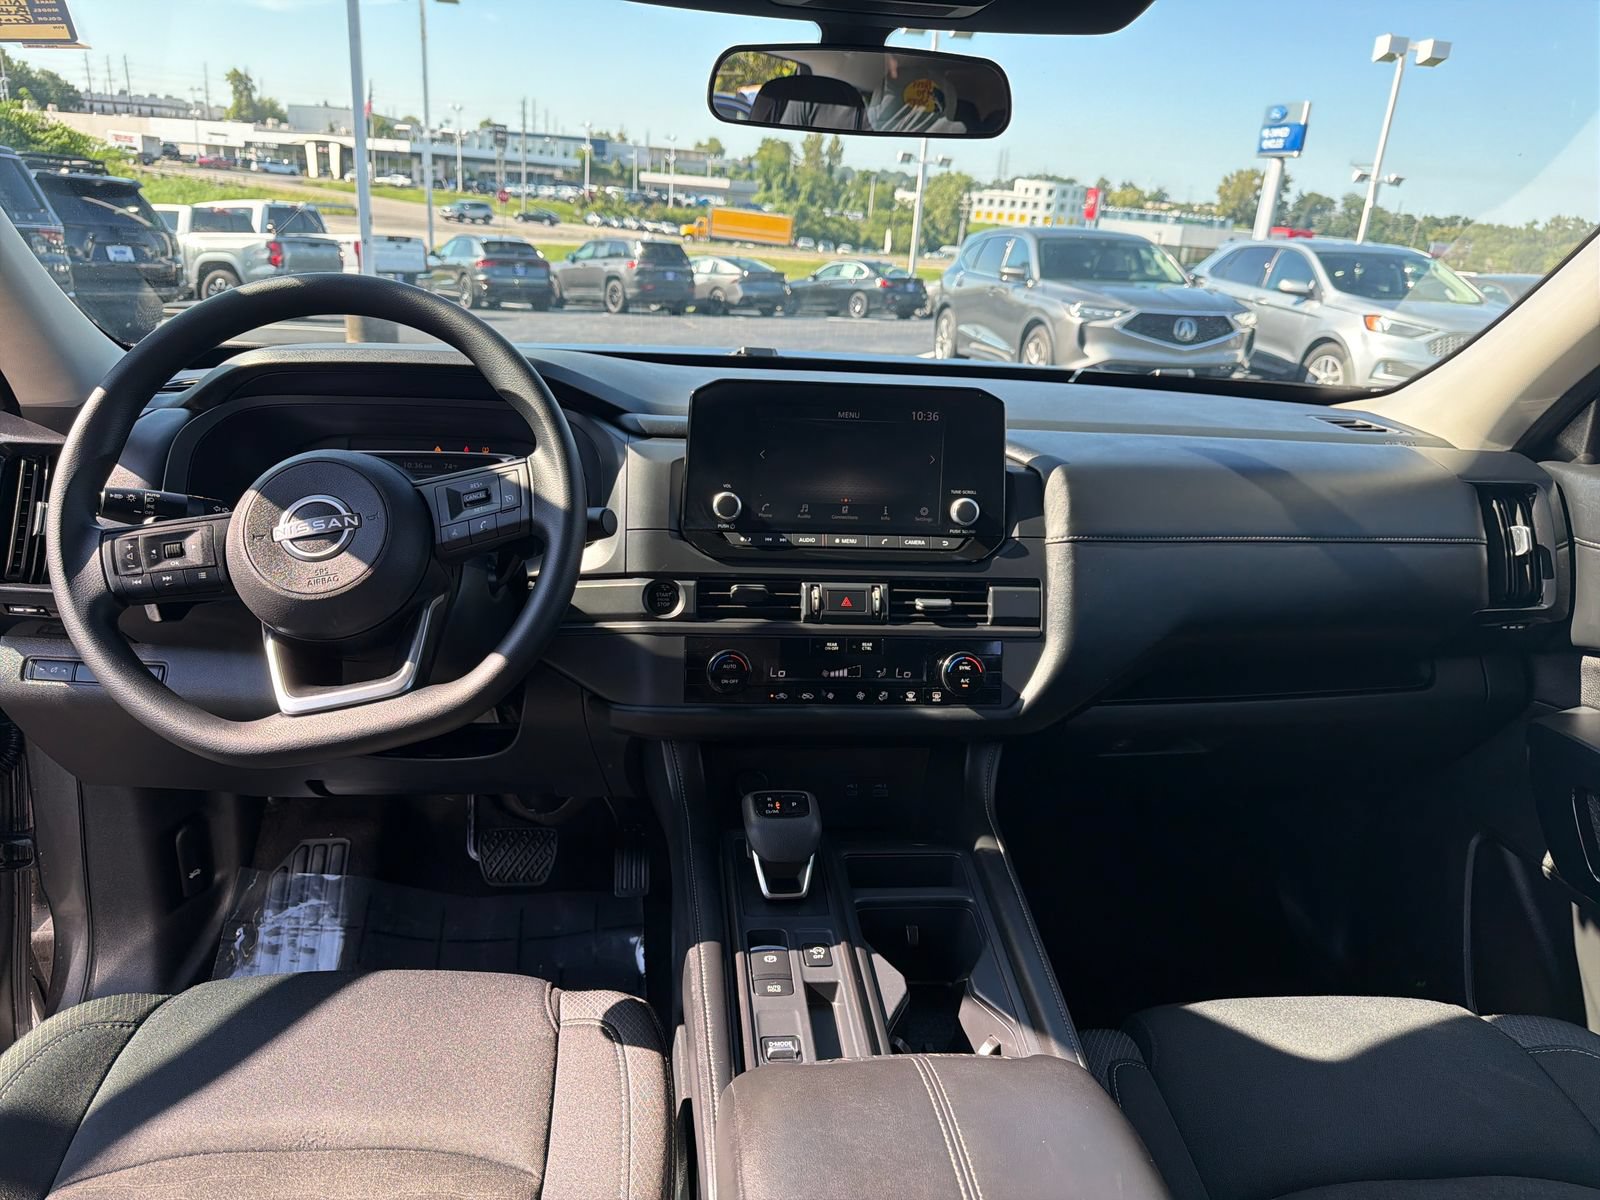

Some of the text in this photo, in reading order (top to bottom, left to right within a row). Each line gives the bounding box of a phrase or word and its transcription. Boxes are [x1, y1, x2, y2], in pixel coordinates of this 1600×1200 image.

[837, 411, 860, 419] MENU
[911, 411, 940, 421] 10:36
[463, 491, 486, 501] CANCEL
[914, 515, 934, 523] Settings
[274, 515, 359, 540] NISSAN
[314, 567, 329, 576] SRS
[306, 574, 341, 588] AIRBAG
